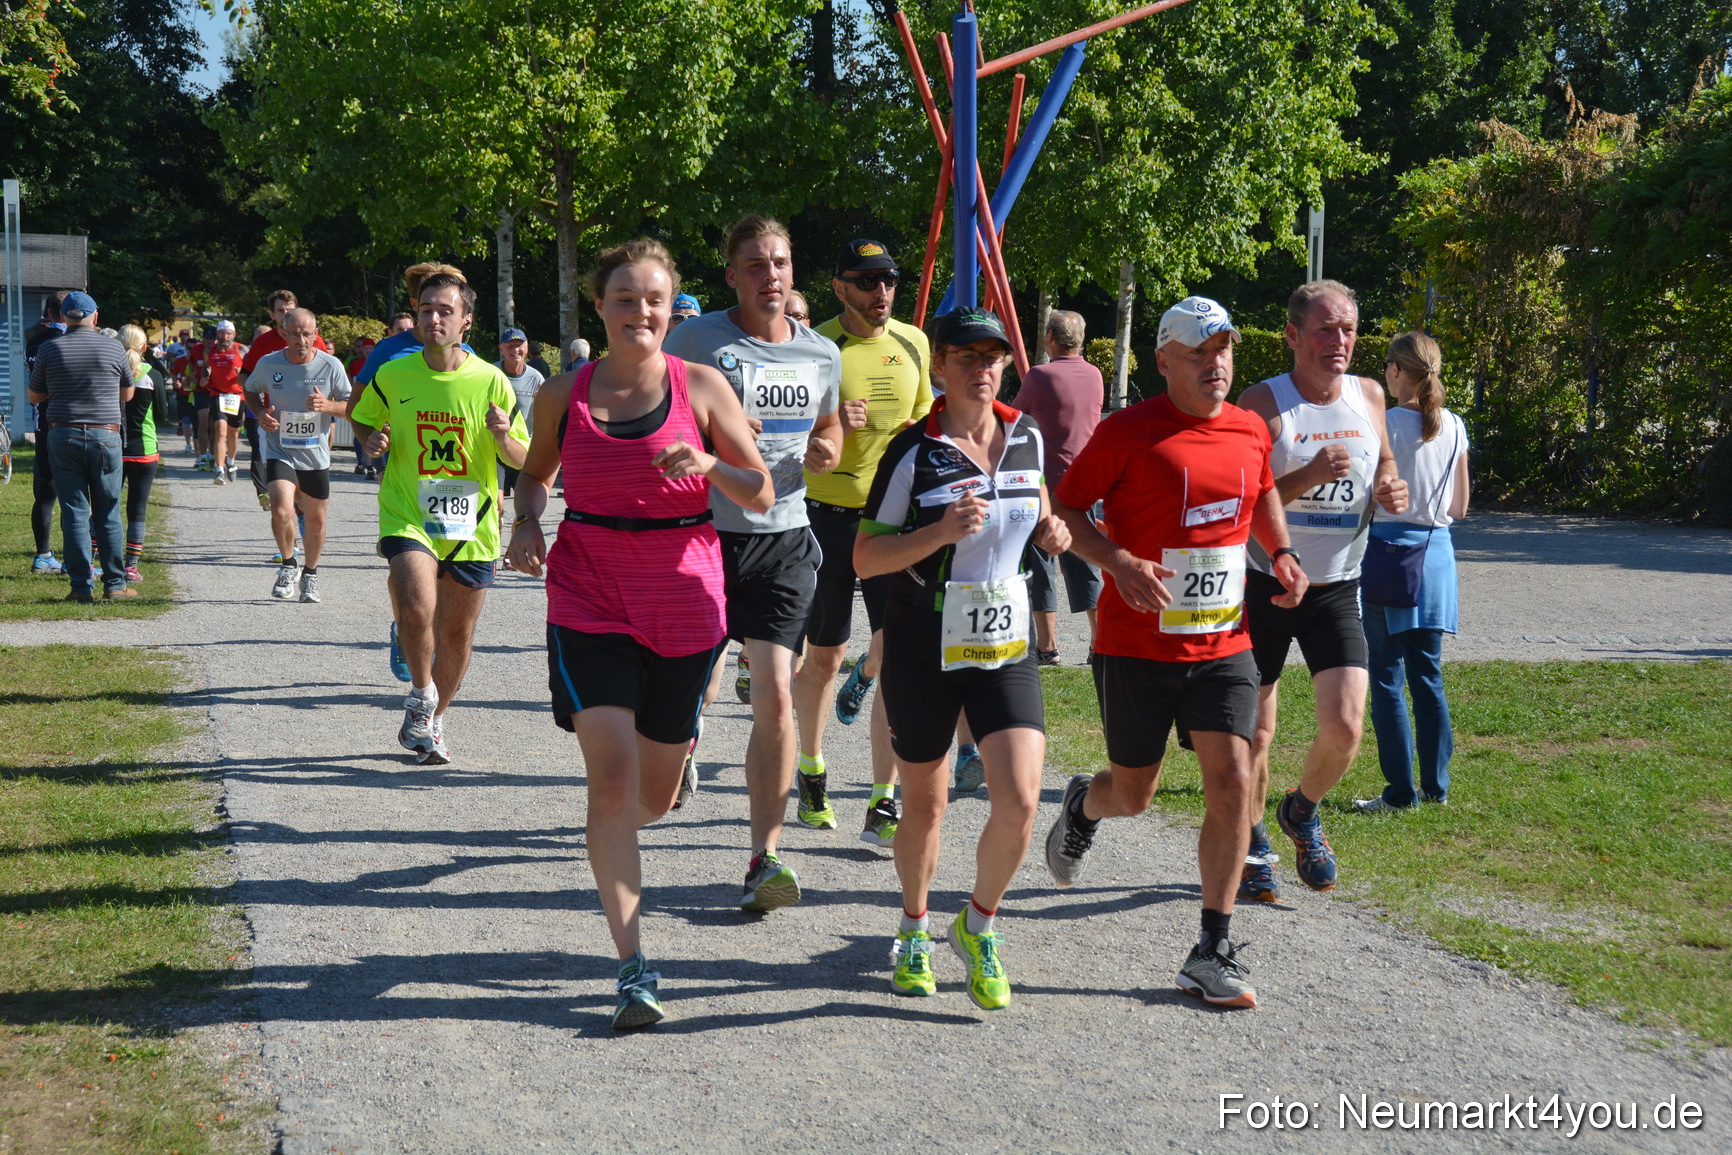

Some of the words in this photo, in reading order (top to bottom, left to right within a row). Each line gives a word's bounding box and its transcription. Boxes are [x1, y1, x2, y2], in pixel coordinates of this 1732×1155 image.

[764, 370, 797, 378] BOCK
[756, 385, 810, 408] 3009
[416, 410, 466, 425] Müller
[286, 422, 315, 434] 2150
[1312, 430, 1365, 441] KLEBL
[429, 439, 456, 462] M
[427, 496, 469, 516] 2189
[1201, 506, 1223, 518] DEHN
[1307, 515, 1342, 526] Roland
[438, 523, 460, 534] Tobias
[1189, 555, 1226, 567] BOCK
[1183, 571, 1229, 597] 267
[967, 604, 1012, 634] 123
[1191, 613, 1218, 623] Mario
[963, 648, 1009, 660] Christina
